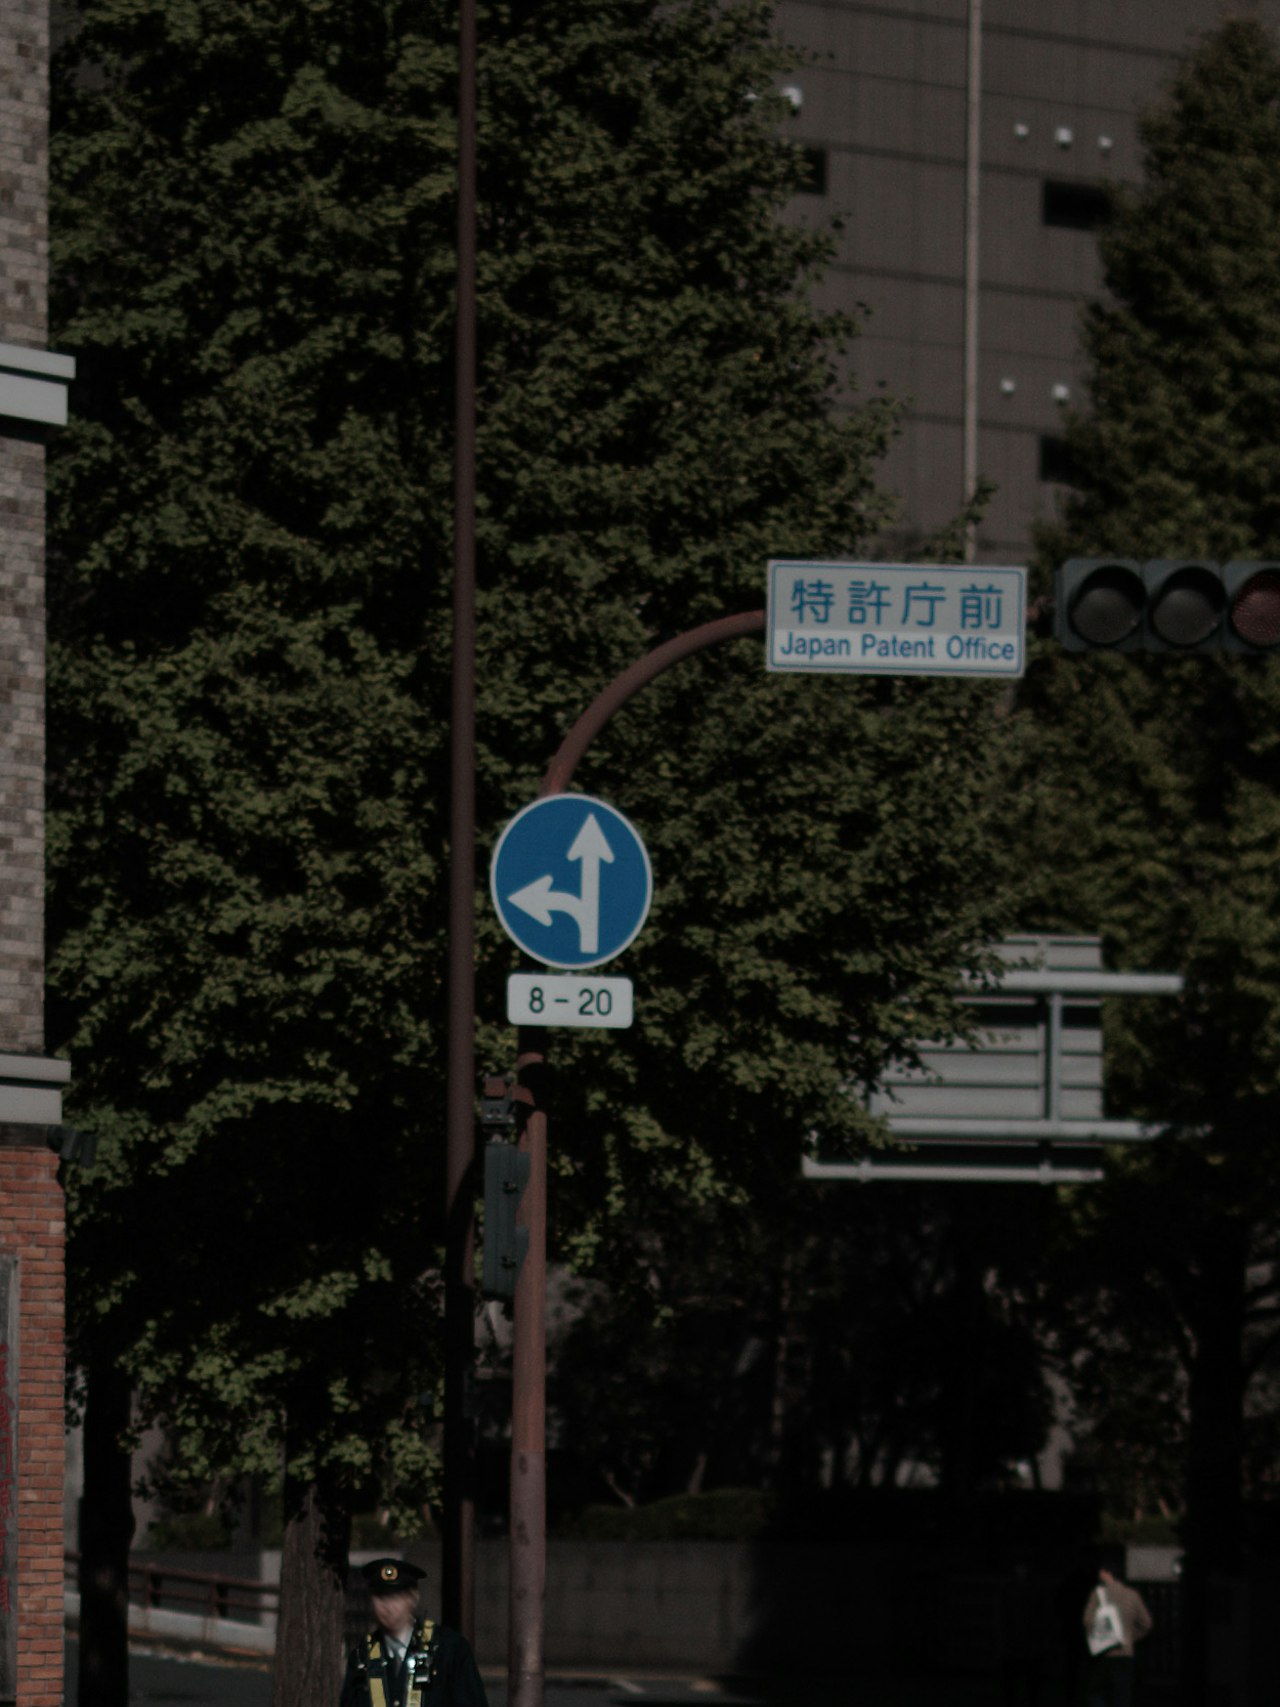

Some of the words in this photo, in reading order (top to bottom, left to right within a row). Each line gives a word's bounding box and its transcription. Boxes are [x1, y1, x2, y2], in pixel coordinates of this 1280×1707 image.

[791, 579, 1004, 629] 特許庁前
[781, 632, 850, 660] Japan
[861, 633, 935, 658] Patent
[946, 635, 1015, 660] Office
